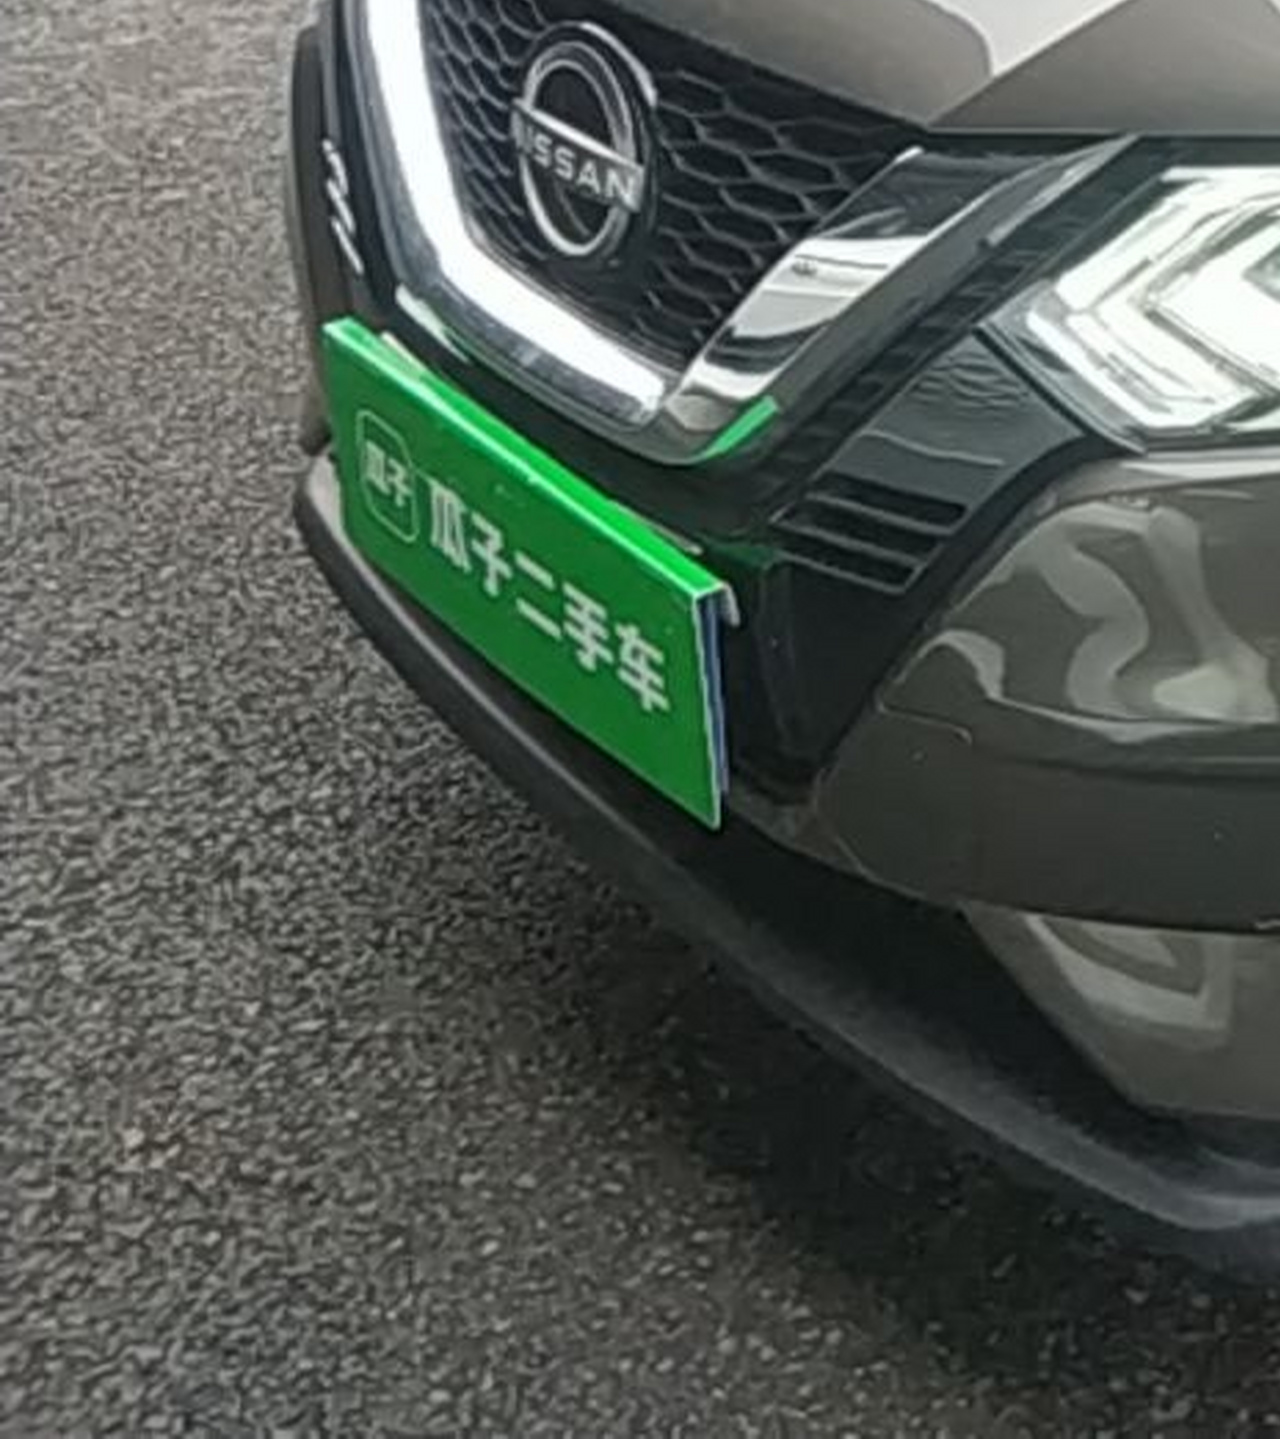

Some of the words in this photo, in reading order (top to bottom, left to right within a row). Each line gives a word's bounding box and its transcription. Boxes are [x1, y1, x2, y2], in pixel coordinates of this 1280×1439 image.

[428, 481, 671, 712] 瓜子二手车
